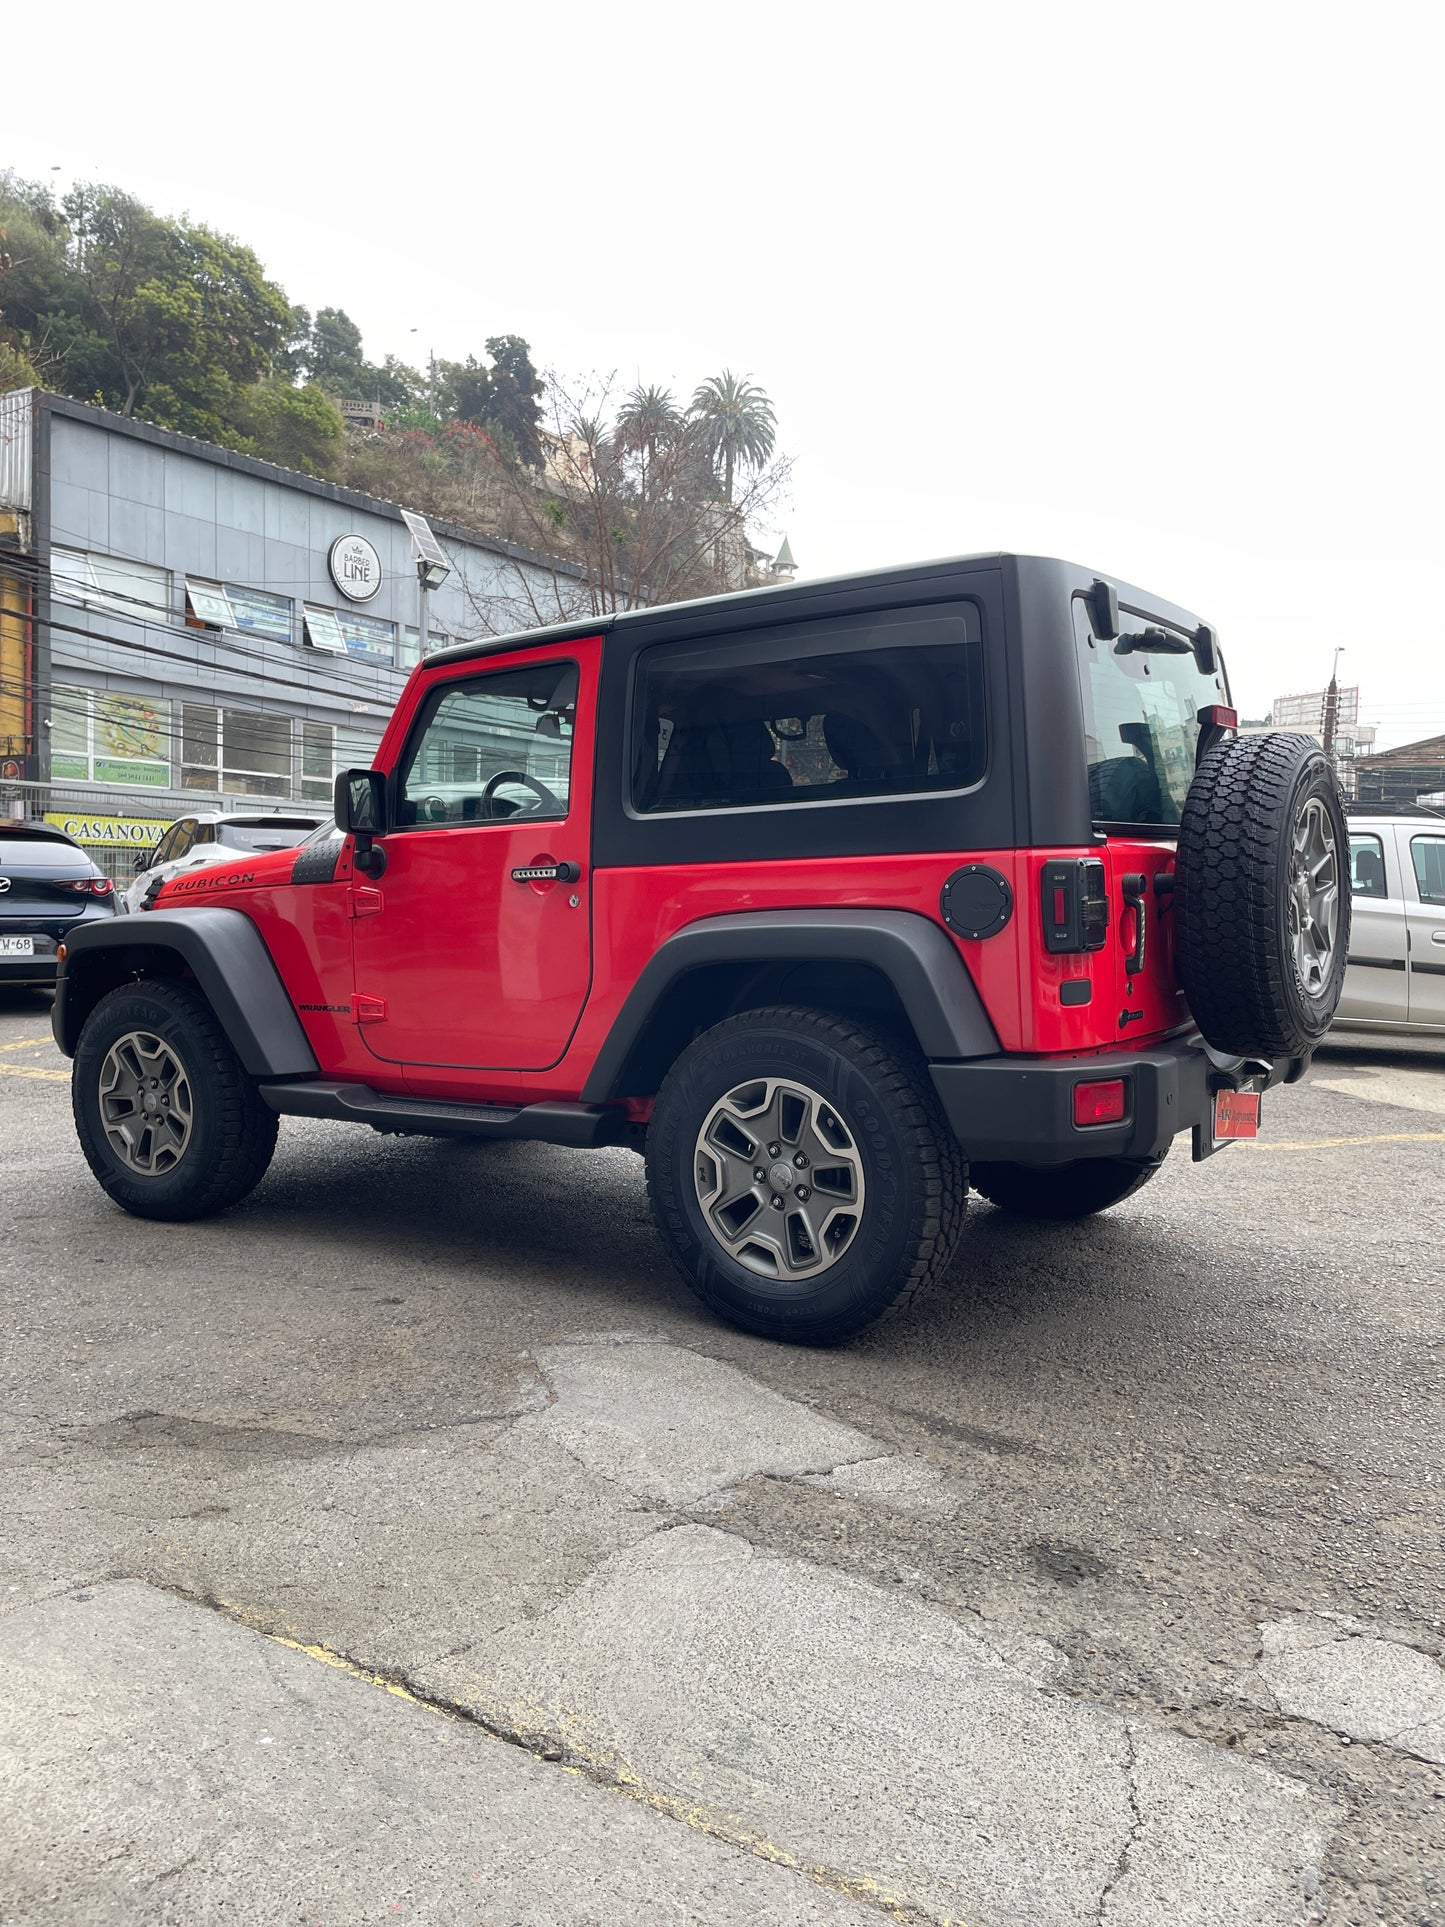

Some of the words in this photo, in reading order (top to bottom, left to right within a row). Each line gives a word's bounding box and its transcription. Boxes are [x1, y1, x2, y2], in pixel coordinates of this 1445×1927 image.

[344, 553, 370, 567] BARBER
[344, 562, 370, 583] LINE
[64, 820, 165, 842] CASANOVA
[173, 873, 255, 892] RUBICON
[299, 1004, 351, 1014] WRANGLER
